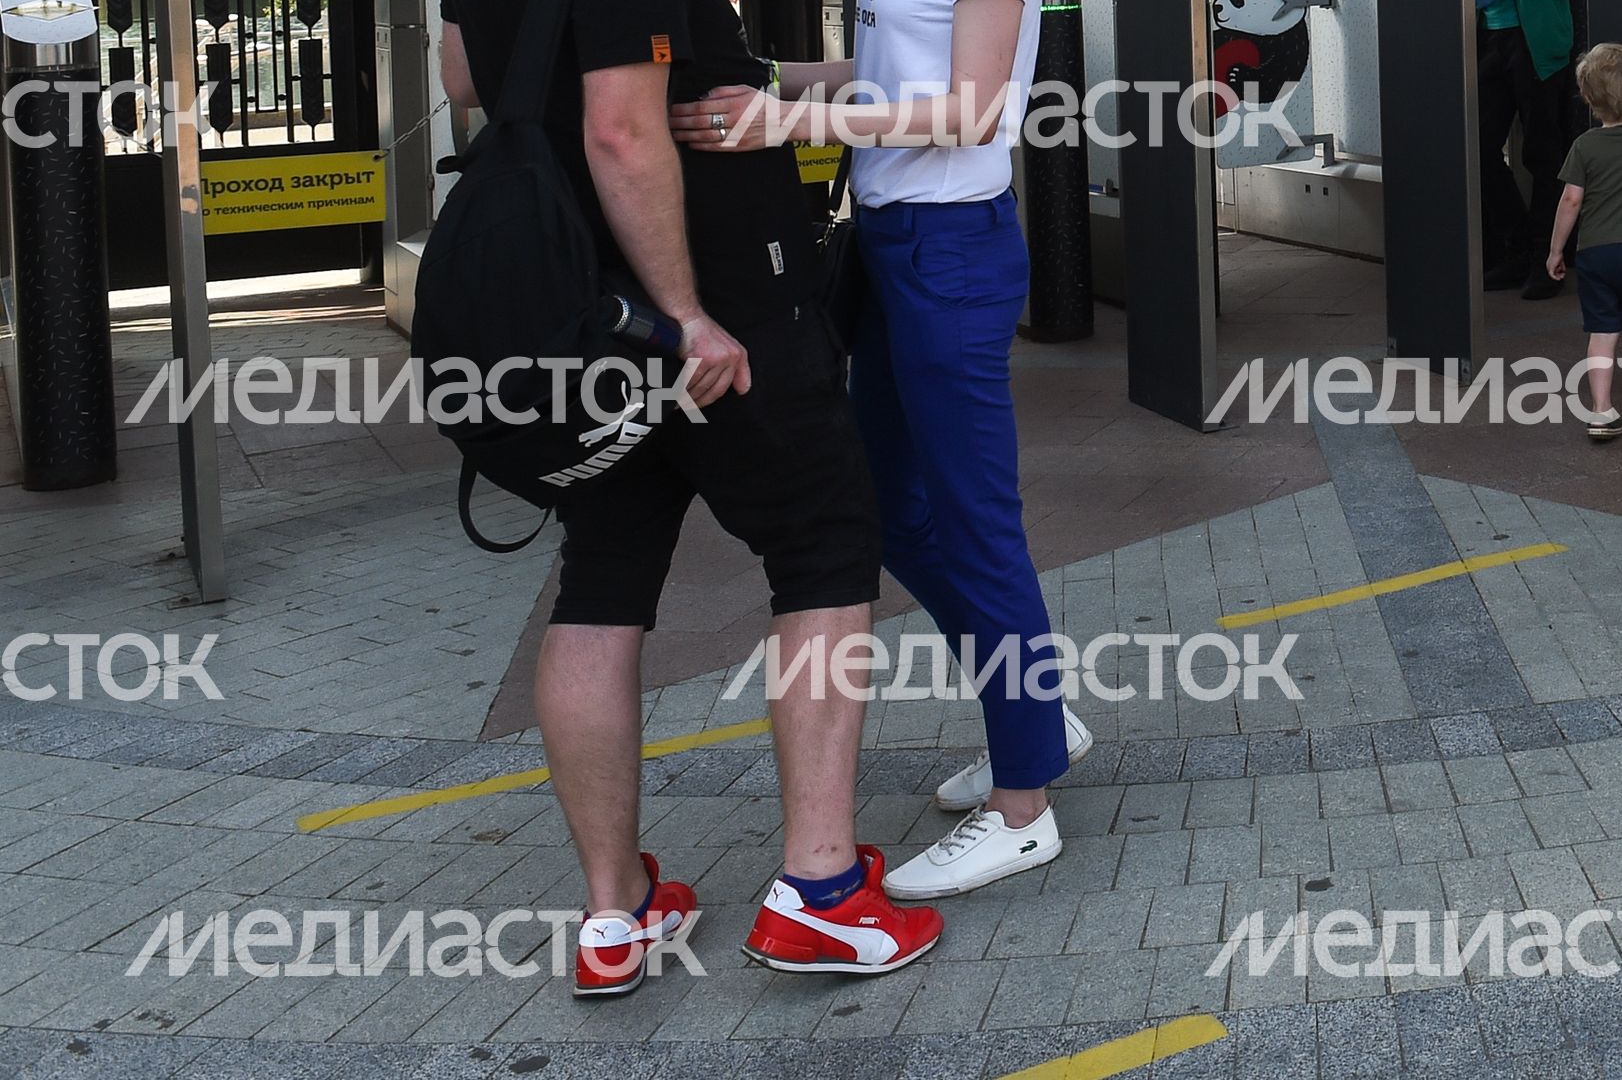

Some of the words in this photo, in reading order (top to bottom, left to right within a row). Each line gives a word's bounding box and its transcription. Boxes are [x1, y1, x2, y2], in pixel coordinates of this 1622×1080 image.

[200, 177, 285, 199] Проход
[290, 170, 375, 191] закрыт
[202, 207, 211, 217] о
[214, 200, 304, 216] техническим
[307, 195, 375, 210] причинам
